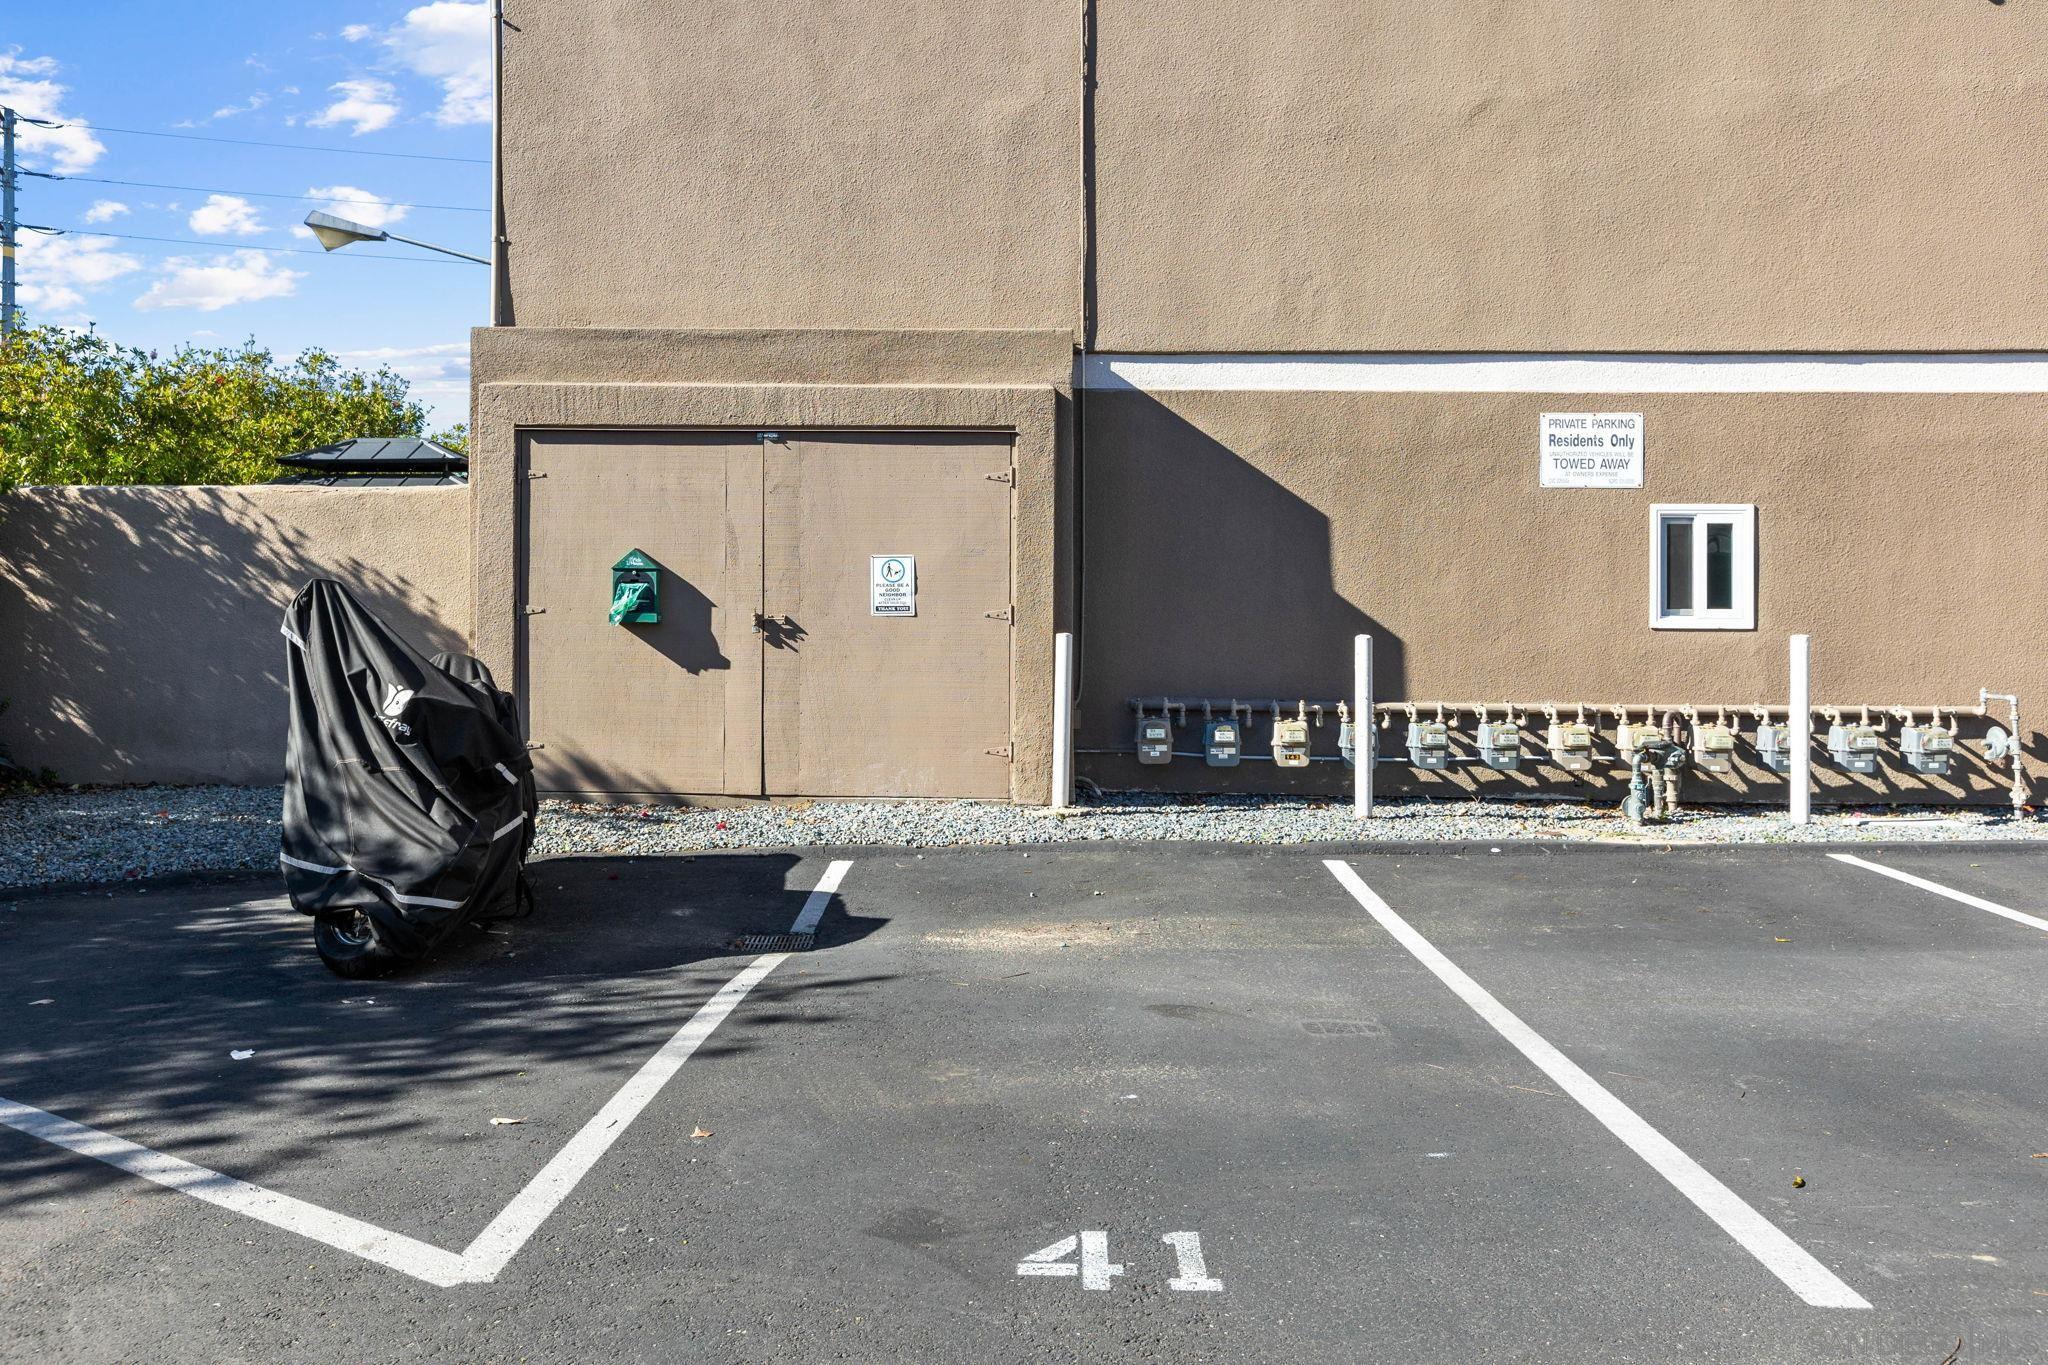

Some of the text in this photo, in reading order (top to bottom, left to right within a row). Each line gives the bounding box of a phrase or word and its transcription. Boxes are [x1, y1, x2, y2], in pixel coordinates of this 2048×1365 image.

[1548, 418, 1636, 429] PRIVATE PARKING
[1548, 433, 1635, 450] Residents Only
[1553, 458, 1631, 470] TOWED AWAY
[1016, 1230, 1224, 1292] 41
